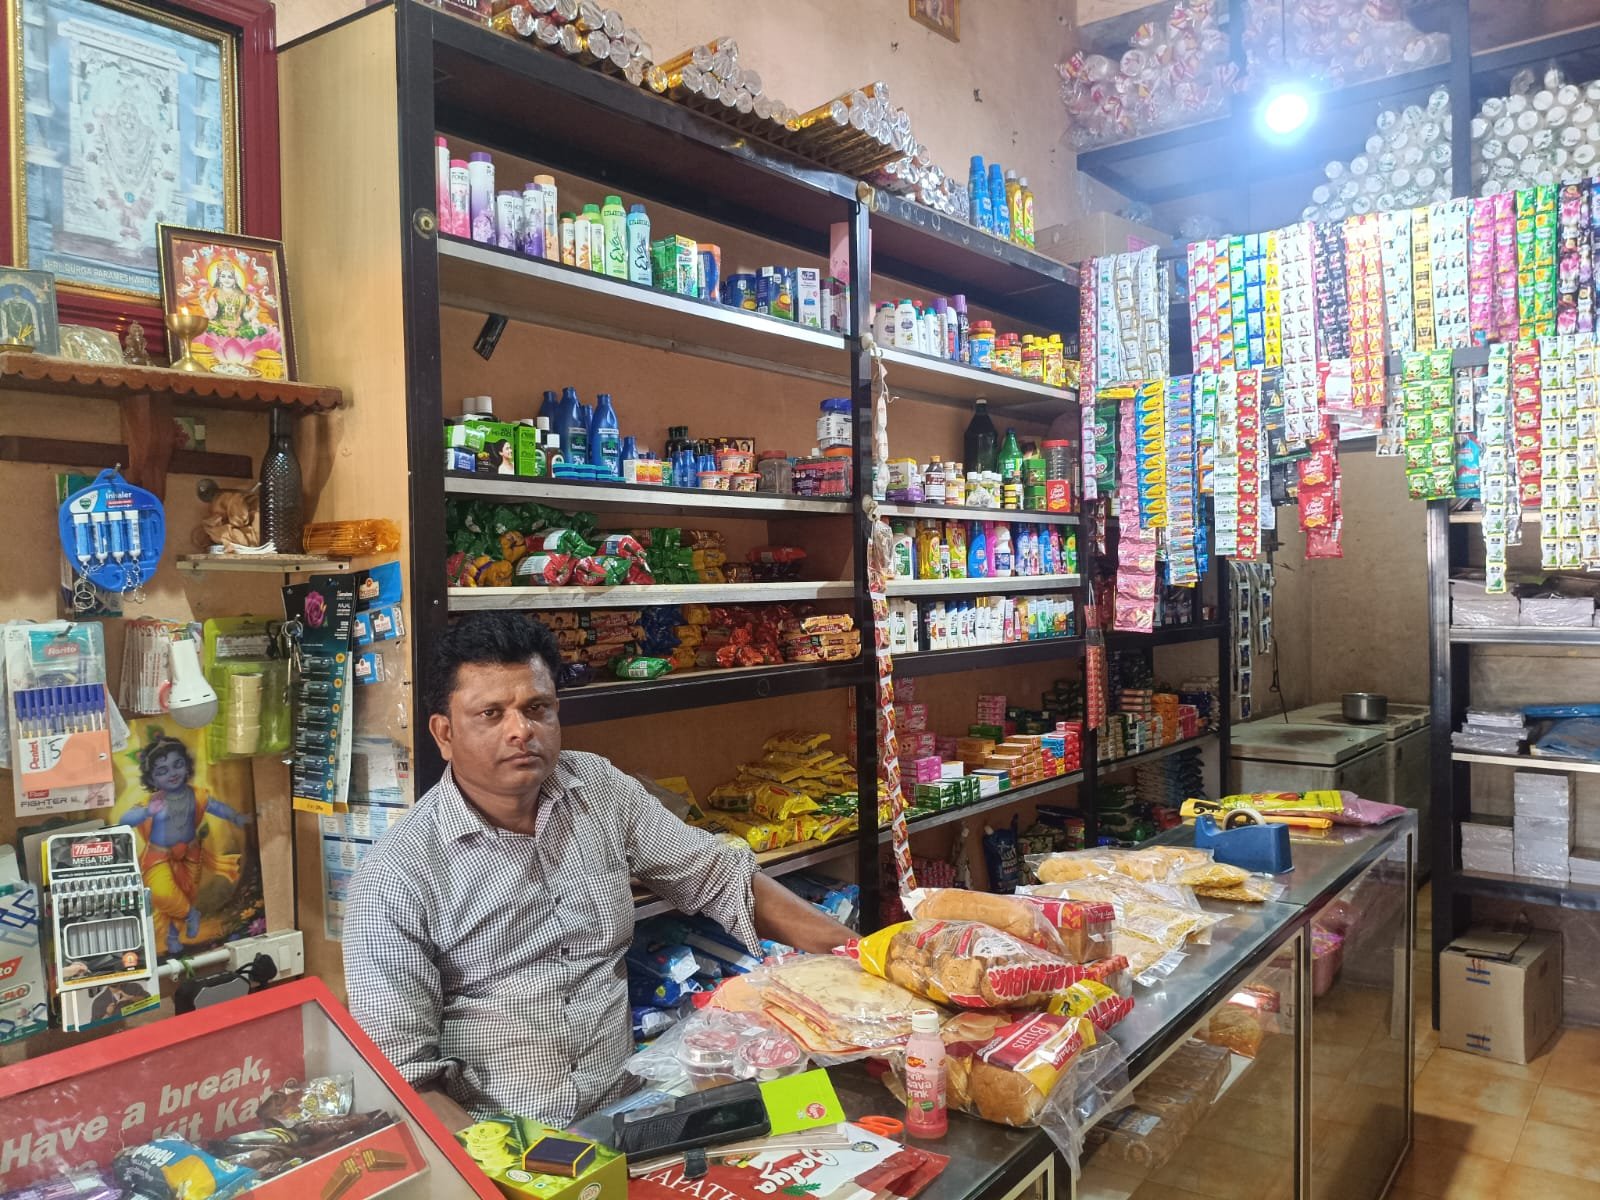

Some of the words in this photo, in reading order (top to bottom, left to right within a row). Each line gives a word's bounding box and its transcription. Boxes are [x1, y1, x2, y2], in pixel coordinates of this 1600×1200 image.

[29, 740, 41, 770] Pentel
[20, 796, 68, 808] FIGHTER
[72, 856, 97, 865] MEGA
[99, 855, 114, 864] TOP
[1011, 1024, 1049, 1050] Buns
[0, 1114, 109, 1176] Have
[121, 1100, 146, 1131] a
[158, 1055, 271, 1117] break,
